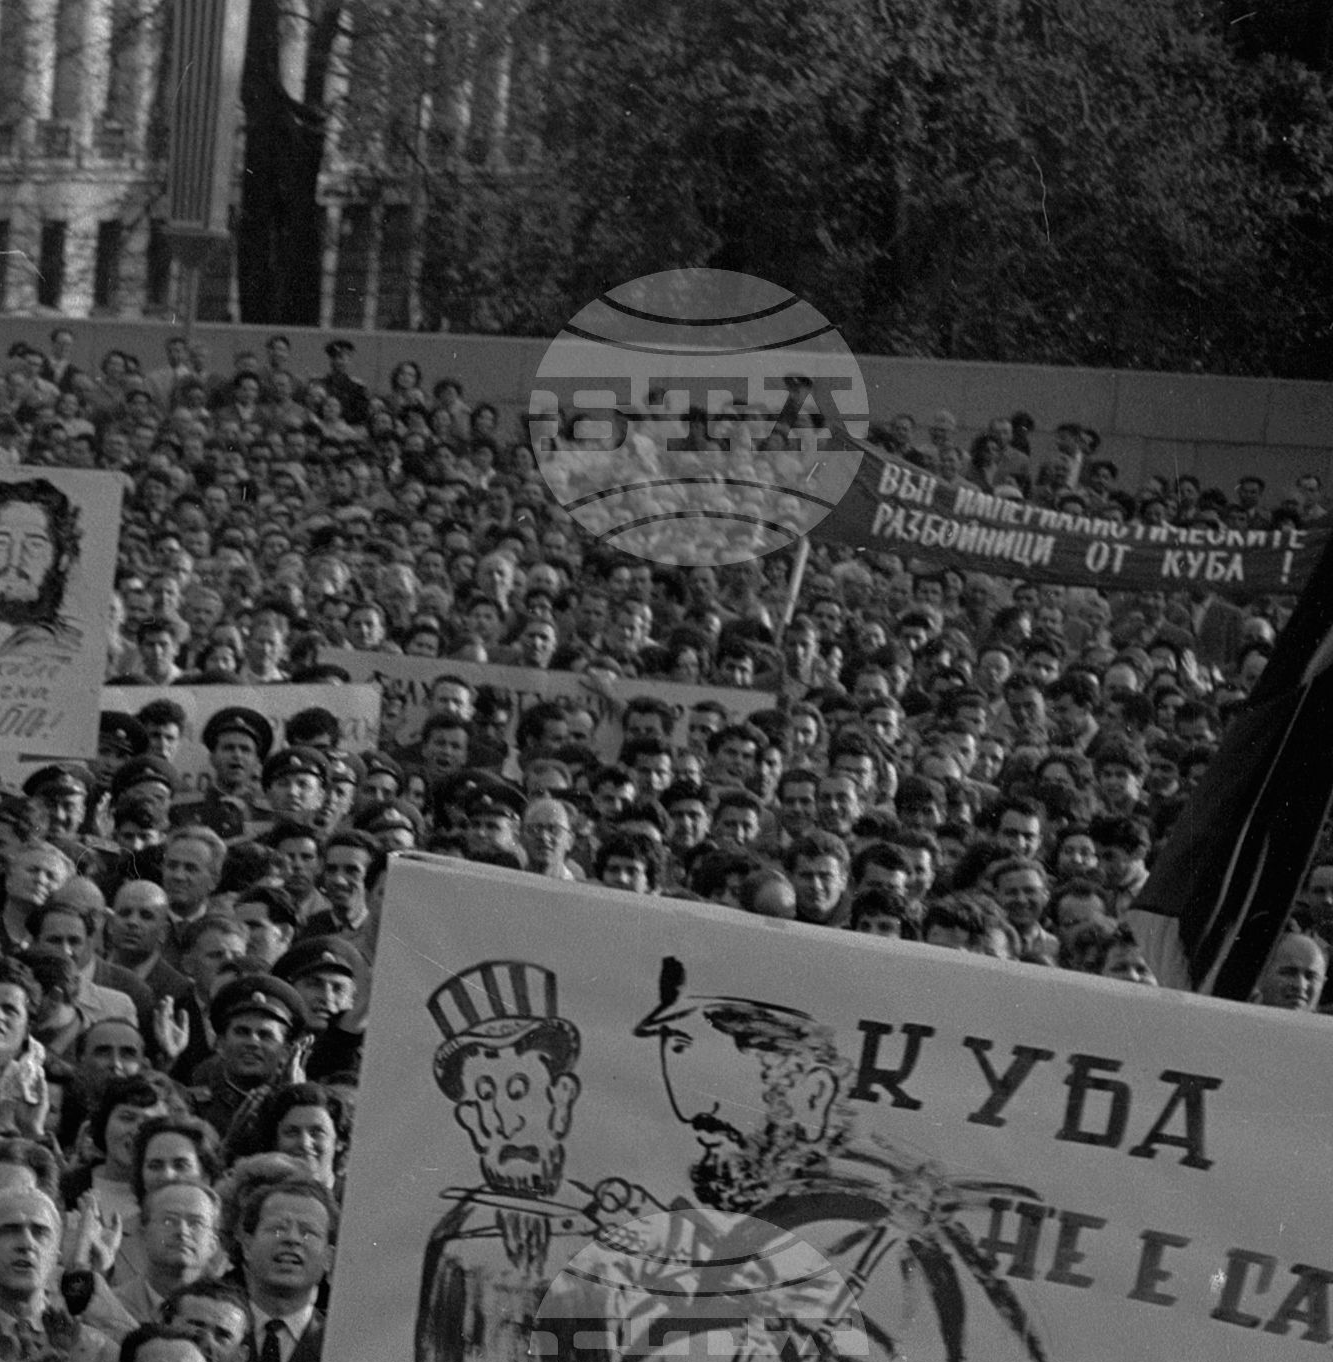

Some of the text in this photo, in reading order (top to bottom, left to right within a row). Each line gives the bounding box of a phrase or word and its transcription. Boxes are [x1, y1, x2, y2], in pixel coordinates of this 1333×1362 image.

[872, 501, 1056, 568] РАЗБОЙНИЦИ
[1086, 540, 1131, 574] ОТ
[1161, 549, 1244, 582] КУБА
[879, 461, 937, 507] ВЪН
[847, 1018, 1224, 1171] КУБА
[978, 1196, 1333, 1345] НЕ Е СА
